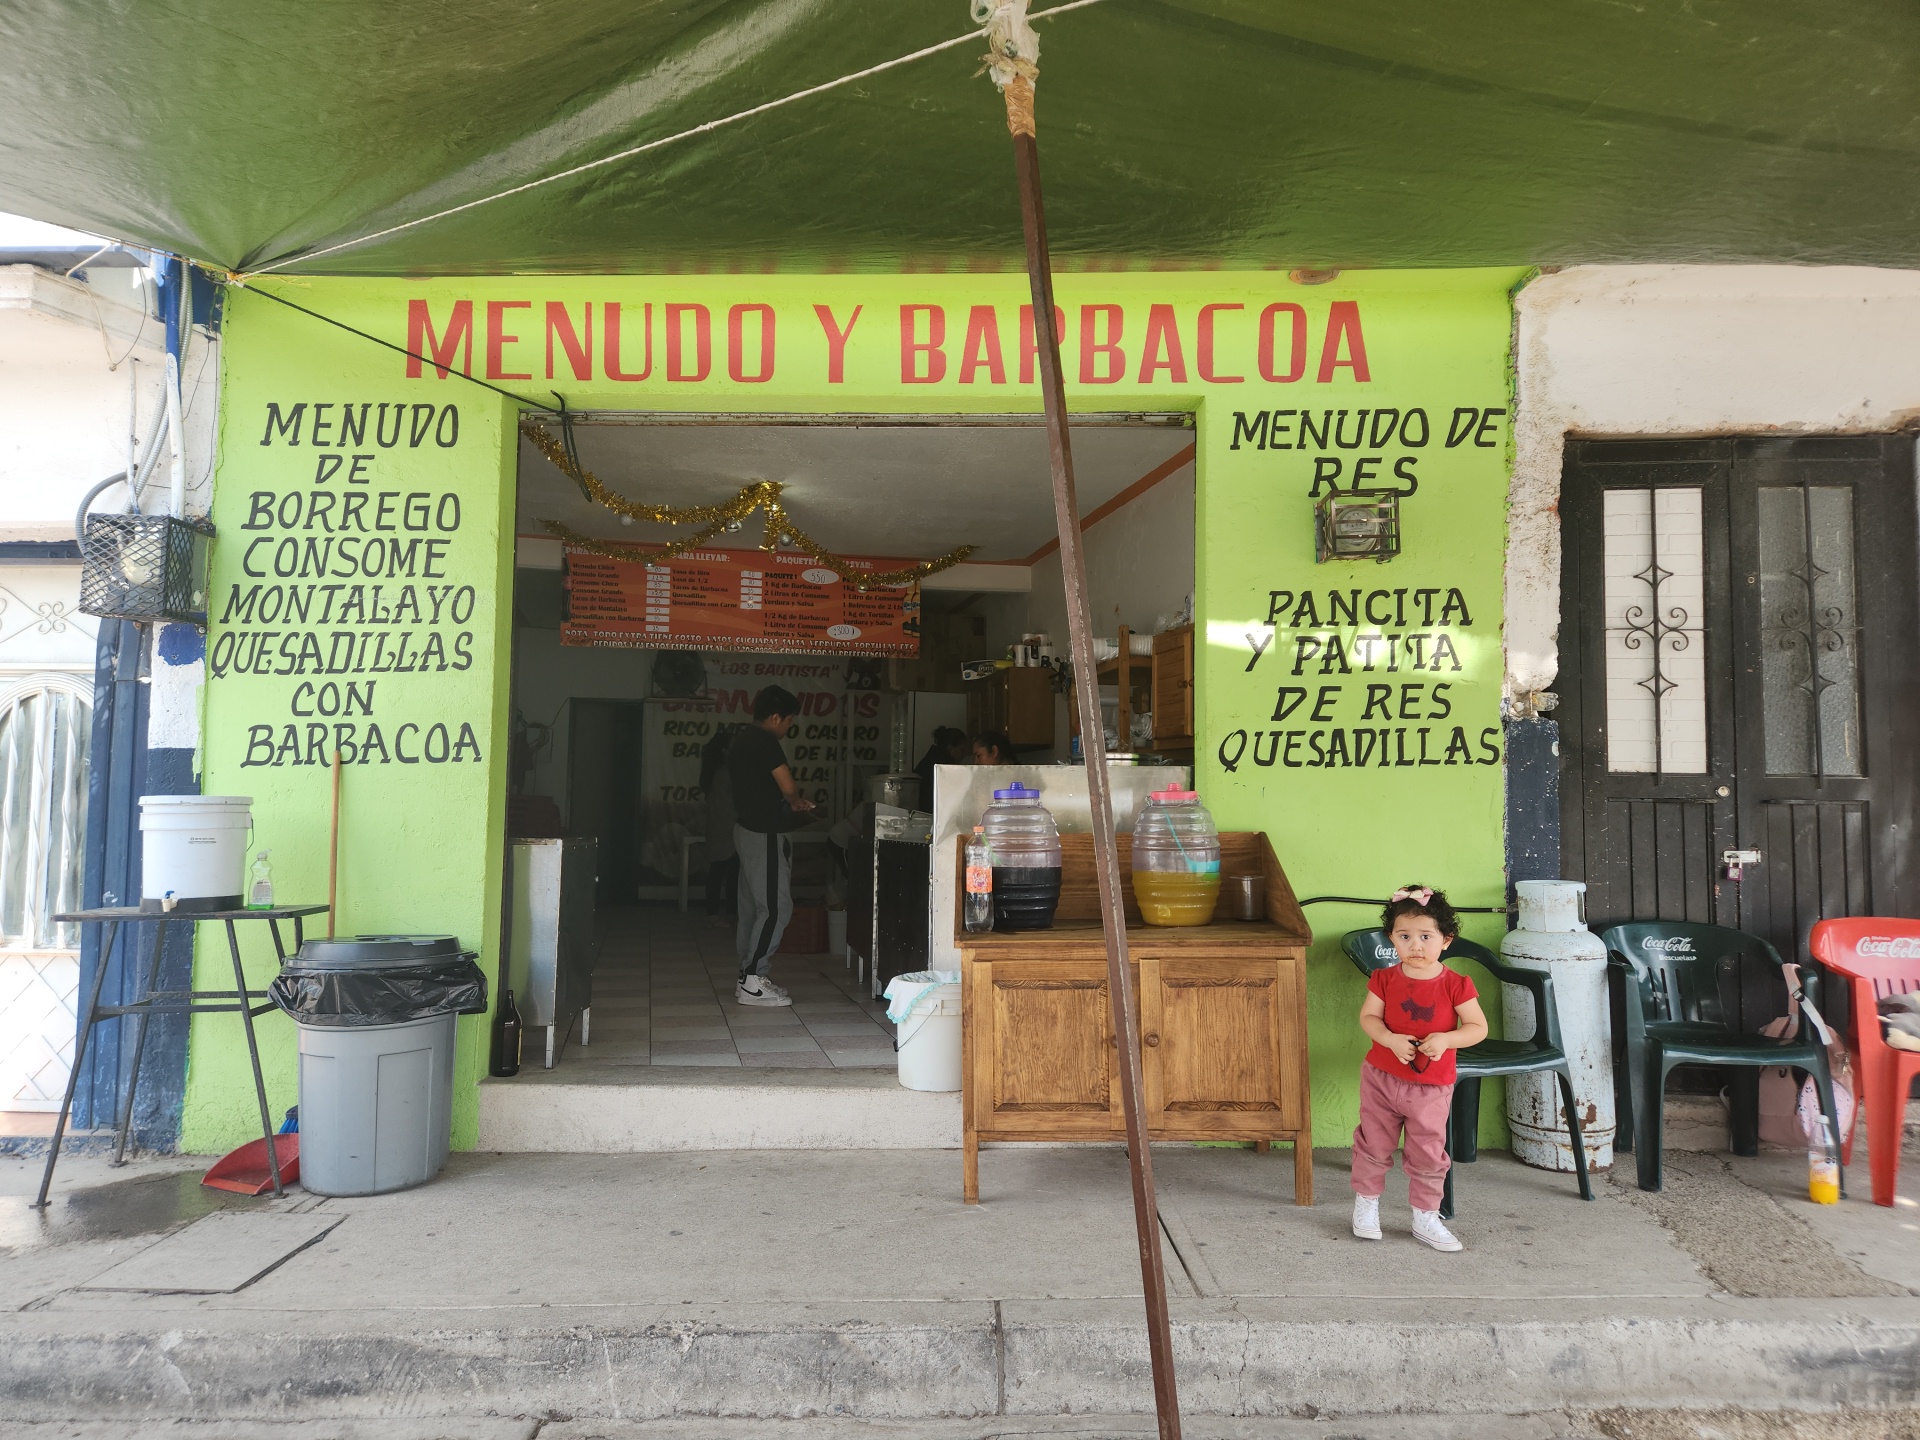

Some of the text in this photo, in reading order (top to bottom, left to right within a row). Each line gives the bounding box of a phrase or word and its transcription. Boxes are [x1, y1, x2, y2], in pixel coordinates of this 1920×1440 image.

[406, 299, 1371, 385] MENUDO Y BARBACOA
[260, 403, 460, 449] MENUDO
[1230, 407, 1506, 450] MENUDO DE
[315, 454, 375, 484] DE
[1308, 456, 1418, 498] RES
[240, 490, 462, 534] BORREGO
[242, 535, 453, 579] CONSOME
[219, 583, 477, 627] MONTALAYO
[1263, 587, 1474, 628] PANCITA
[210, 631, 473, 680] QUESADILLAS
[1245, 632, 1463, 676] Y PATITA
[290, 679, 377, 717] CON
[1271, 682, 1452, 722] DE RES
[240, 721, 483, 769] BARBACOA
[663, 720, 710, 737] RICO
[1218, 726, 1500, 773] QUESADILLAS
[794, 745, 821, 761] DE
[1641, 935, 1693, 952] Coca-Cola
